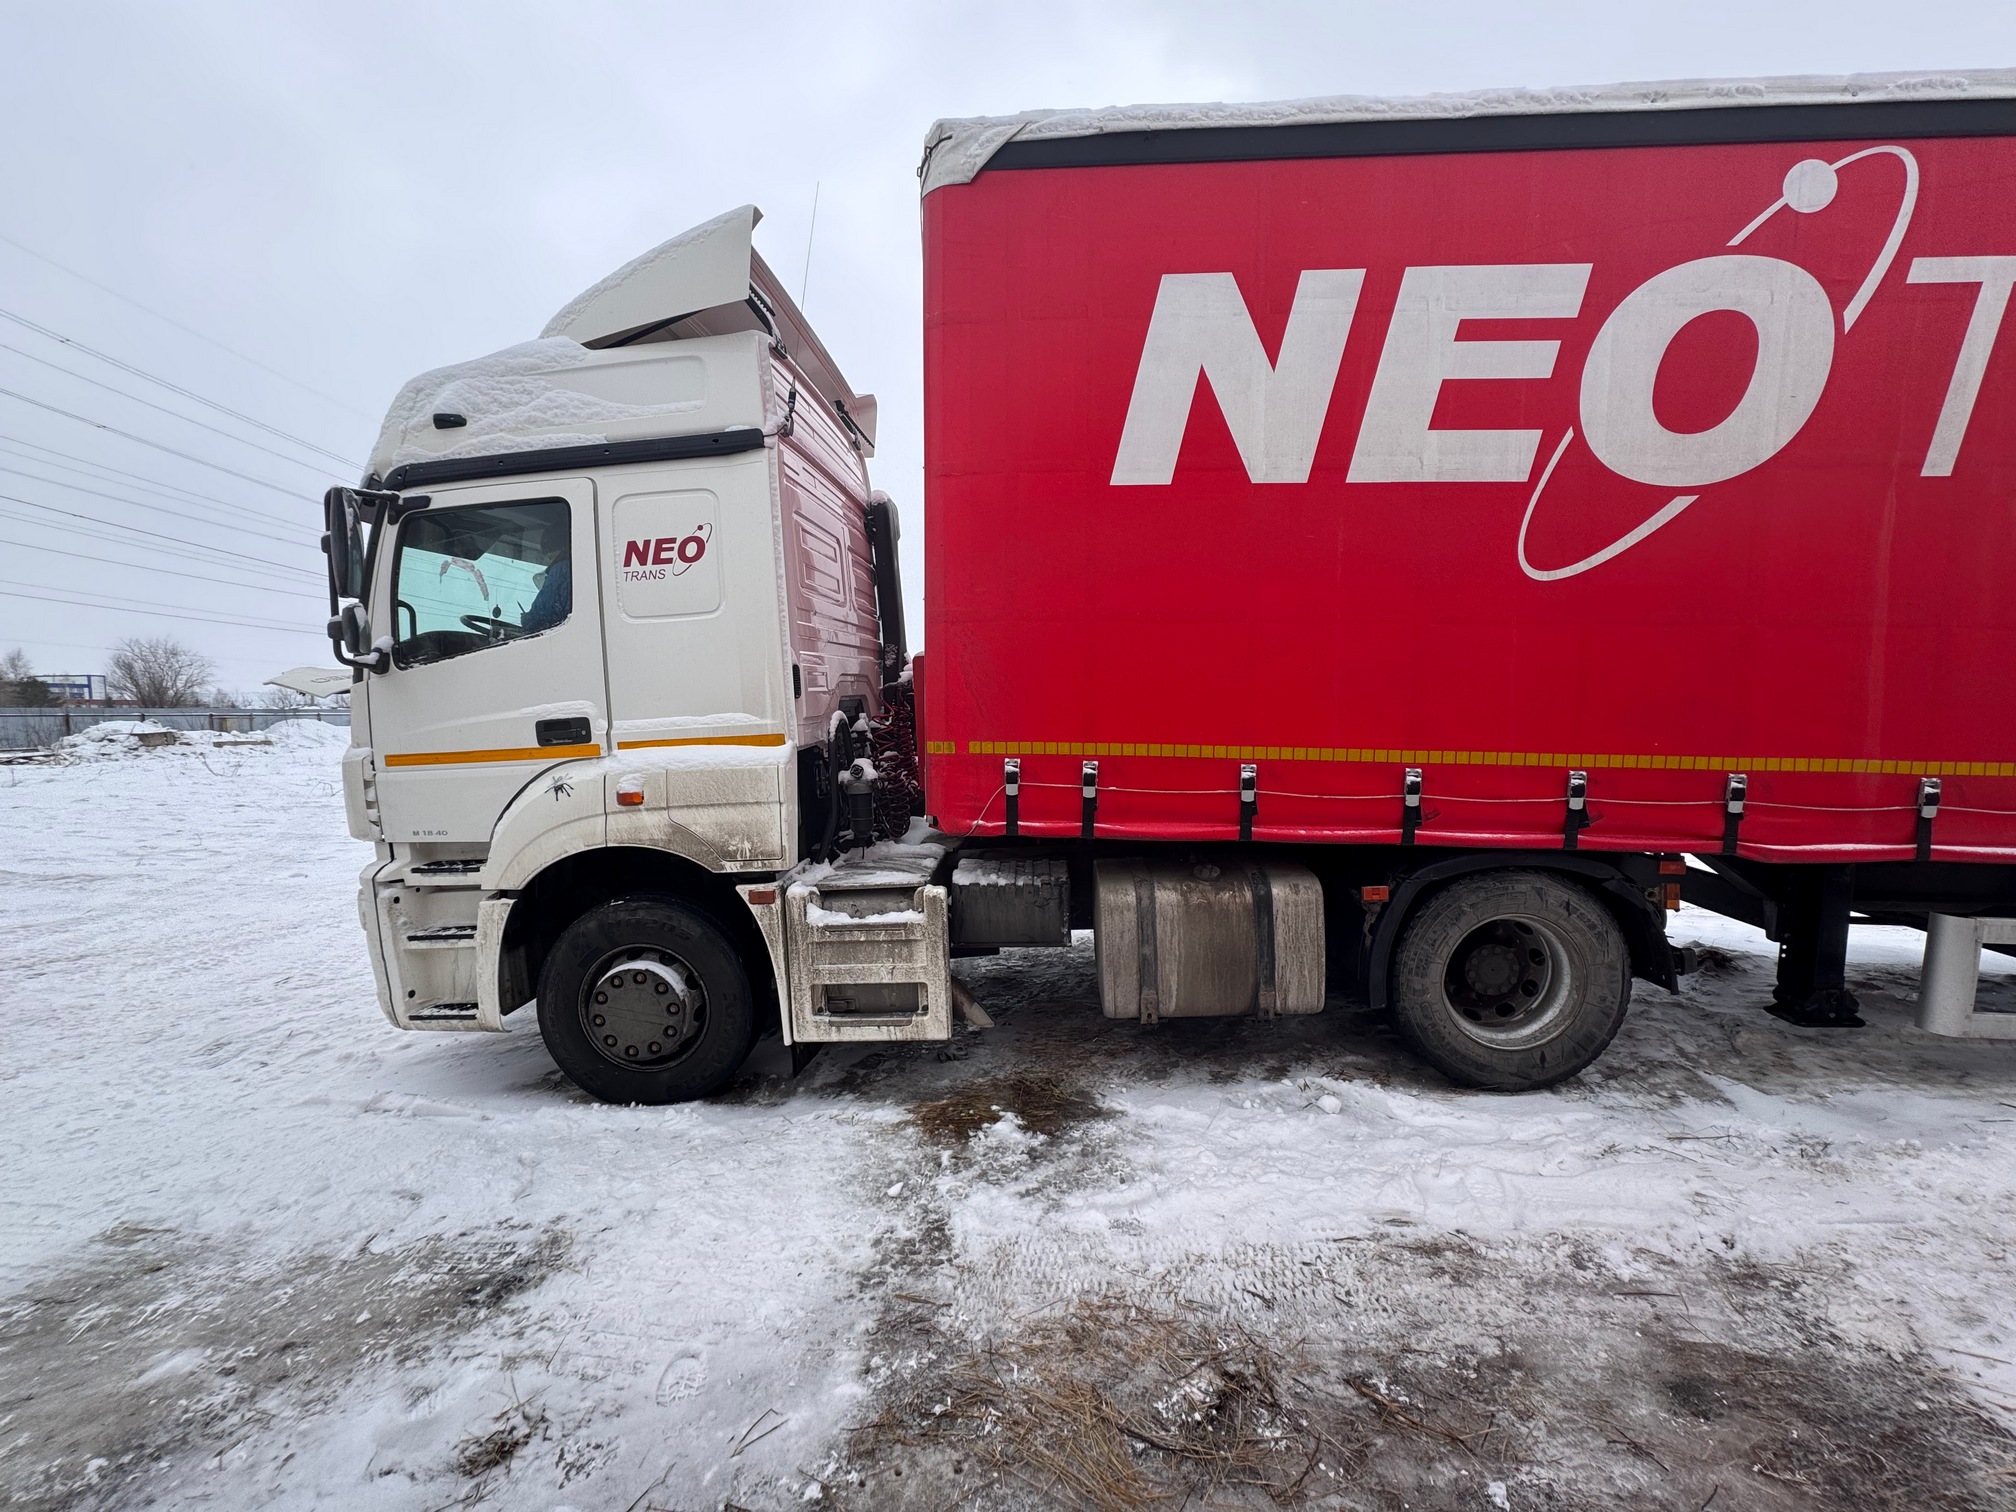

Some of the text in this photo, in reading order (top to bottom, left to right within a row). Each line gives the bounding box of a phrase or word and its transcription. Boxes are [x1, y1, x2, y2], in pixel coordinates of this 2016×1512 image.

[1109, 254, 1836, 487] NEO
[623, 535, 706, 568] NEO
[623, 568, 667, 582] TRANS
